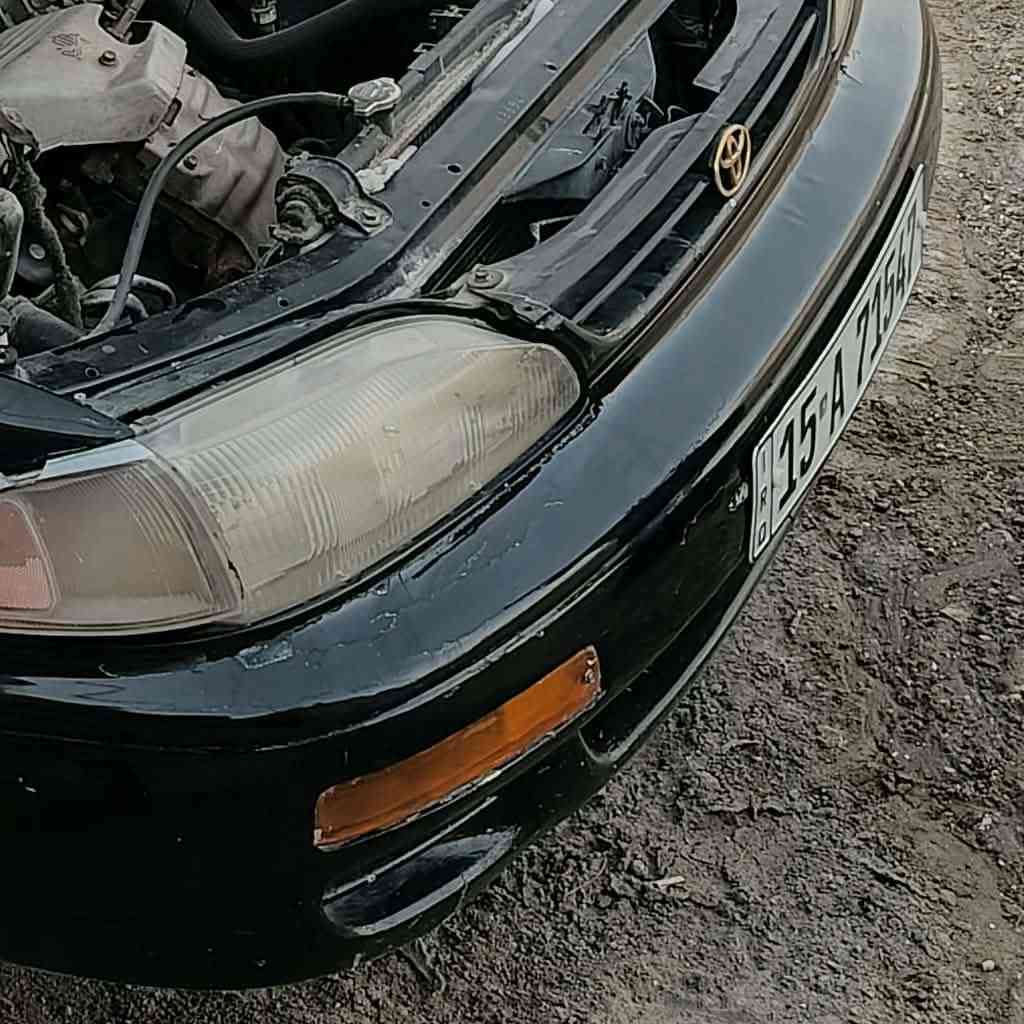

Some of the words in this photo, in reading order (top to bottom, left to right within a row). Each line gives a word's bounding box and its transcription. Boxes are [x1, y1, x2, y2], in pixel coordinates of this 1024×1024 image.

[778, 386, 818, 511] 15
[829, 347, 846, 437] A
[856, 199, 918, 389] 71547
